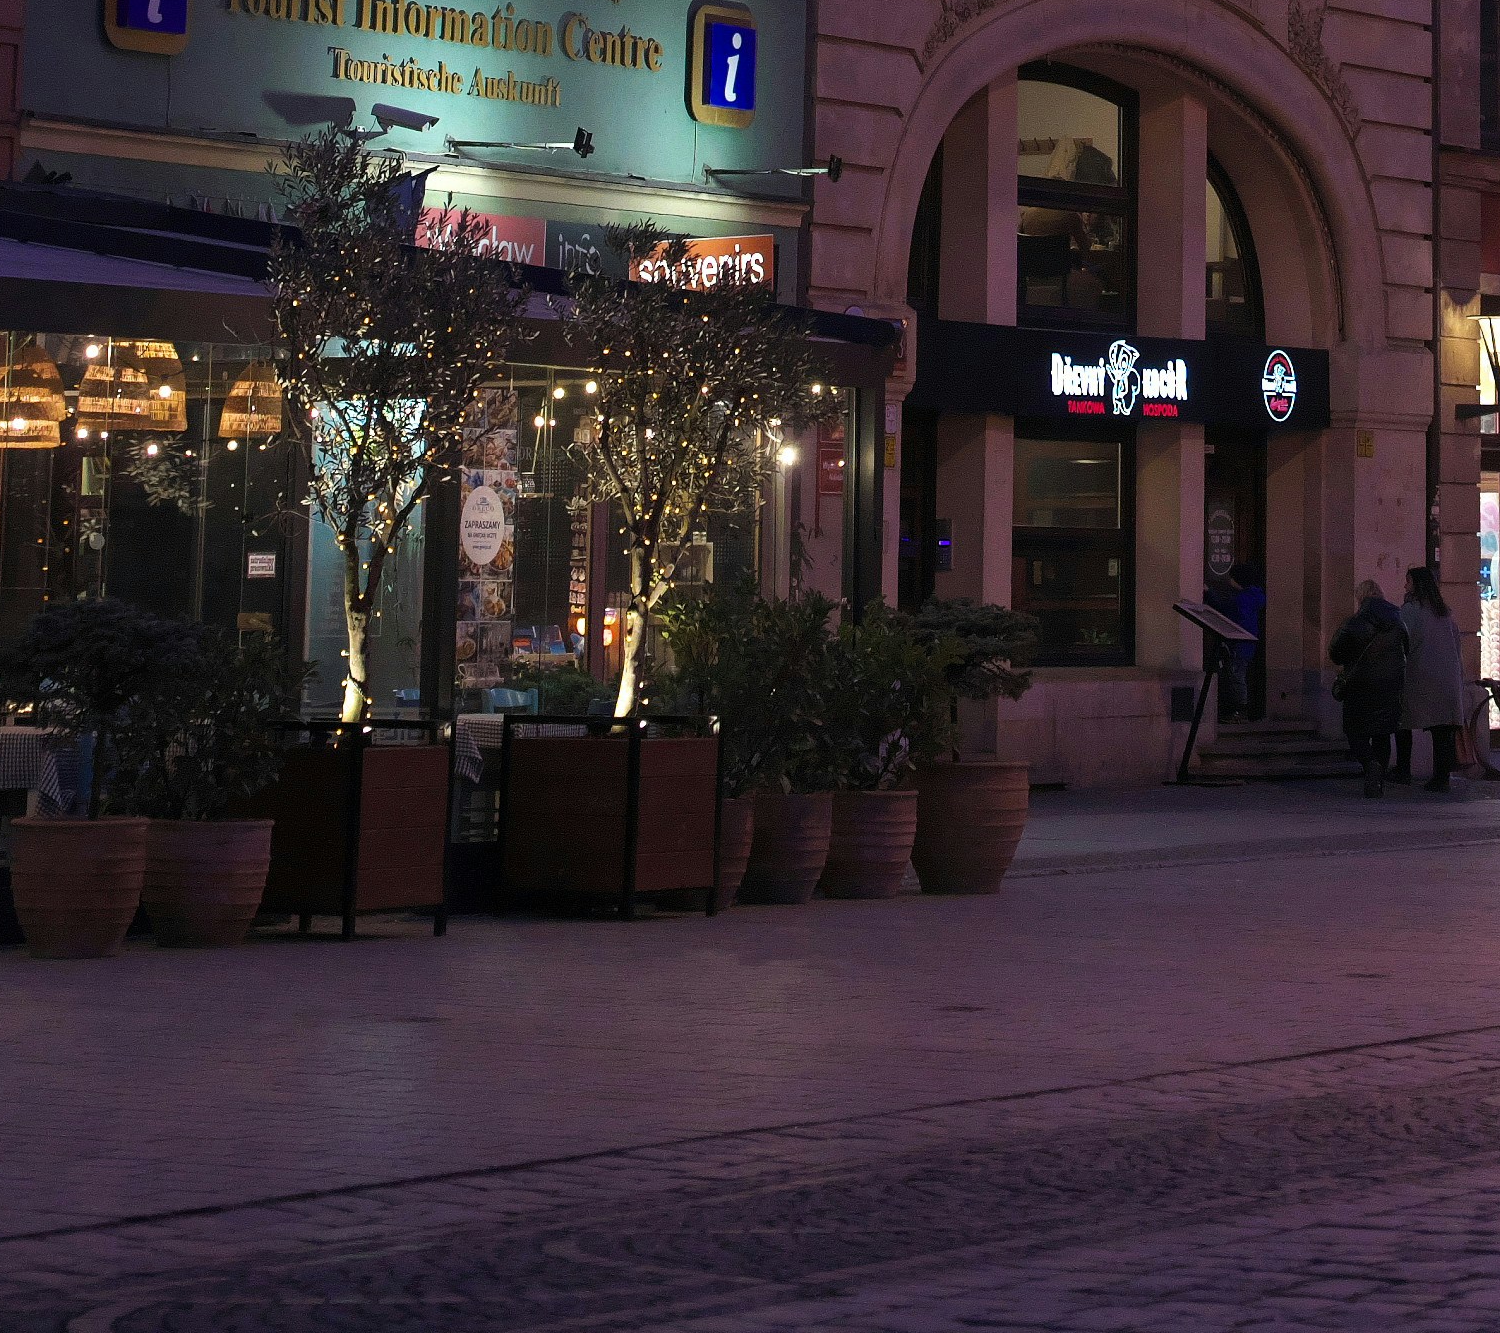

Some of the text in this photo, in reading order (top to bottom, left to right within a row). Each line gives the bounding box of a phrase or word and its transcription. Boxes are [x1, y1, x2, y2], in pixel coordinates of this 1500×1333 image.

[562, 10, 664, 71] Centre
[331, 46, 563, 107] Touristische Auskunft
[638, 244, 765, 290] souvenirs
[1067, 400, 1179, 418] TANKOWA HOSPODA
[464, 520, 501, 529] ZAPRASZAMY
